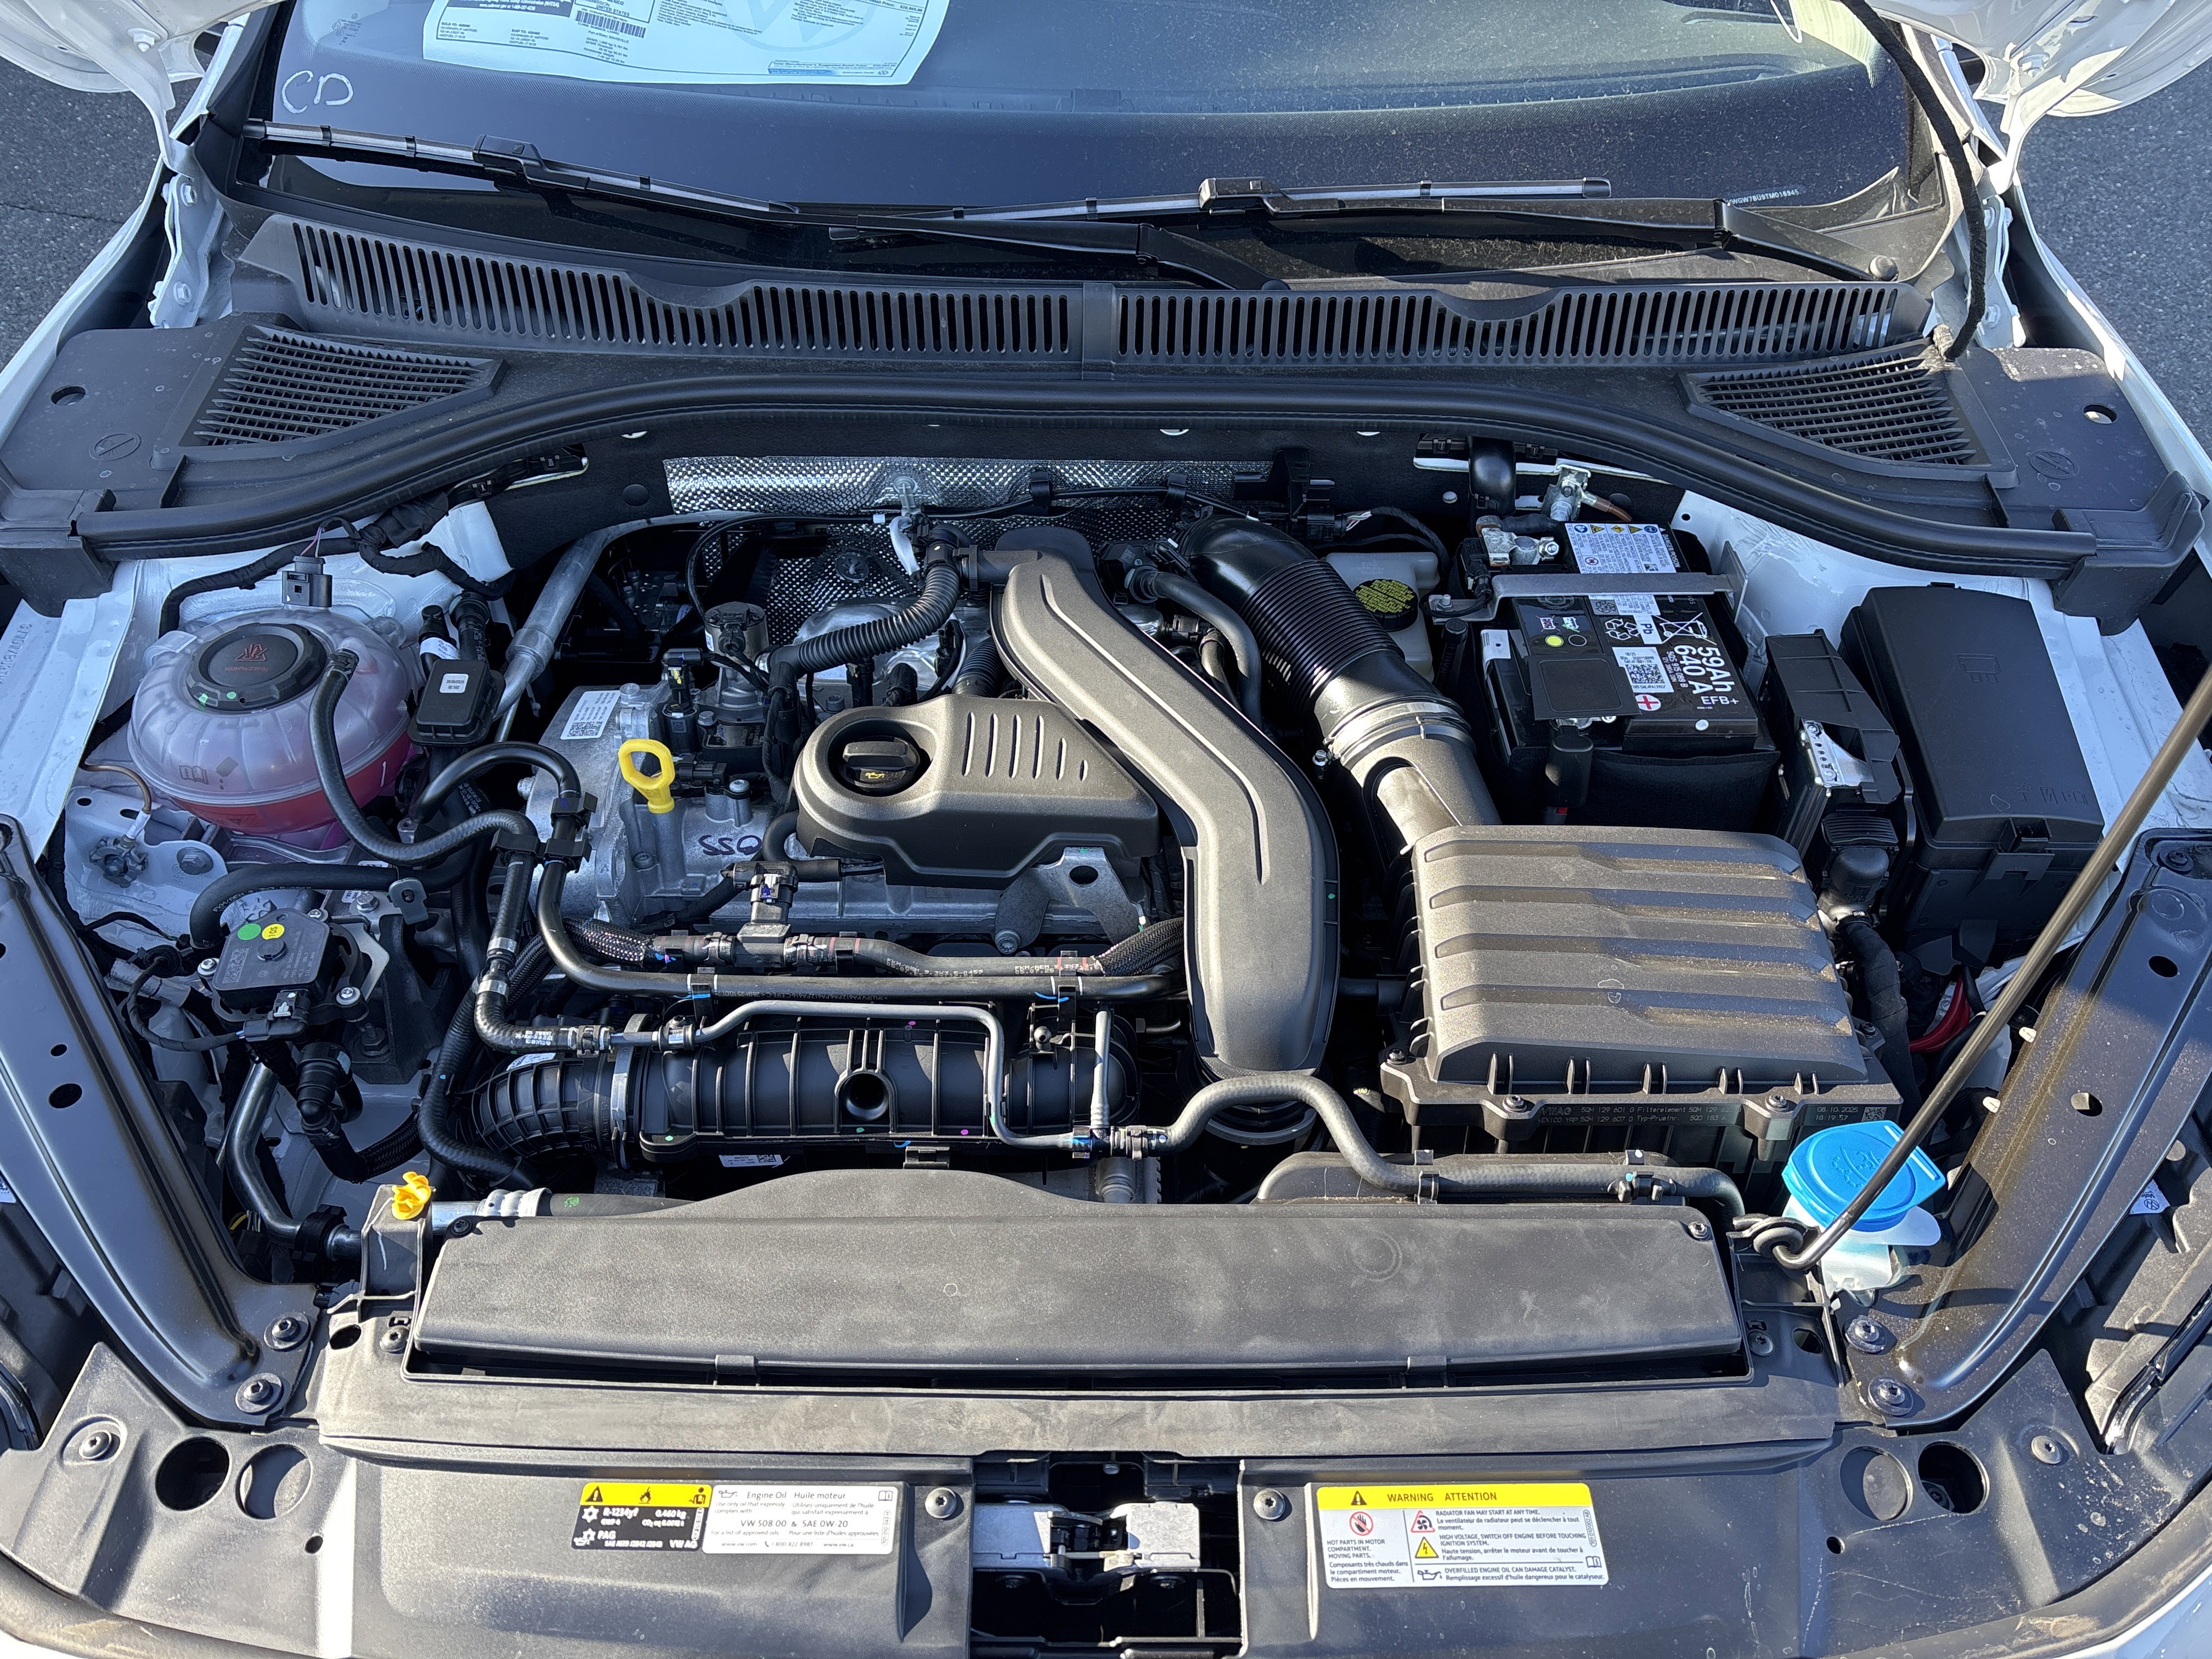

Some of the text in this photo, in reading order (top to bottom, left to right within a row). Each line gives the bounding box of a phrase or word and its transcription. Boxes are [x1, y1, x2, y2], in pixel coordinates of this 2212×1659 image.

[613, 8, 630, 16] STATES
[1725, 189, 1799, 205] VWGW7BU9TM016945
[1640, 623, 1654, 635] Pb
[1674, 645, 1706, 676] 640
[1698, 646, 1735, 692] 59Ah
[1688, 680, 1713, 695] A
[1701, 696, 1739, 705] EFB+
[747, 1492, 774, 1500] Engine
[1387, 1491, 1497, 1502] WARNING ATTENTION
[597, 1530, 616, 1539] PAG
[669, 1539, 698, 1549] VW AG
